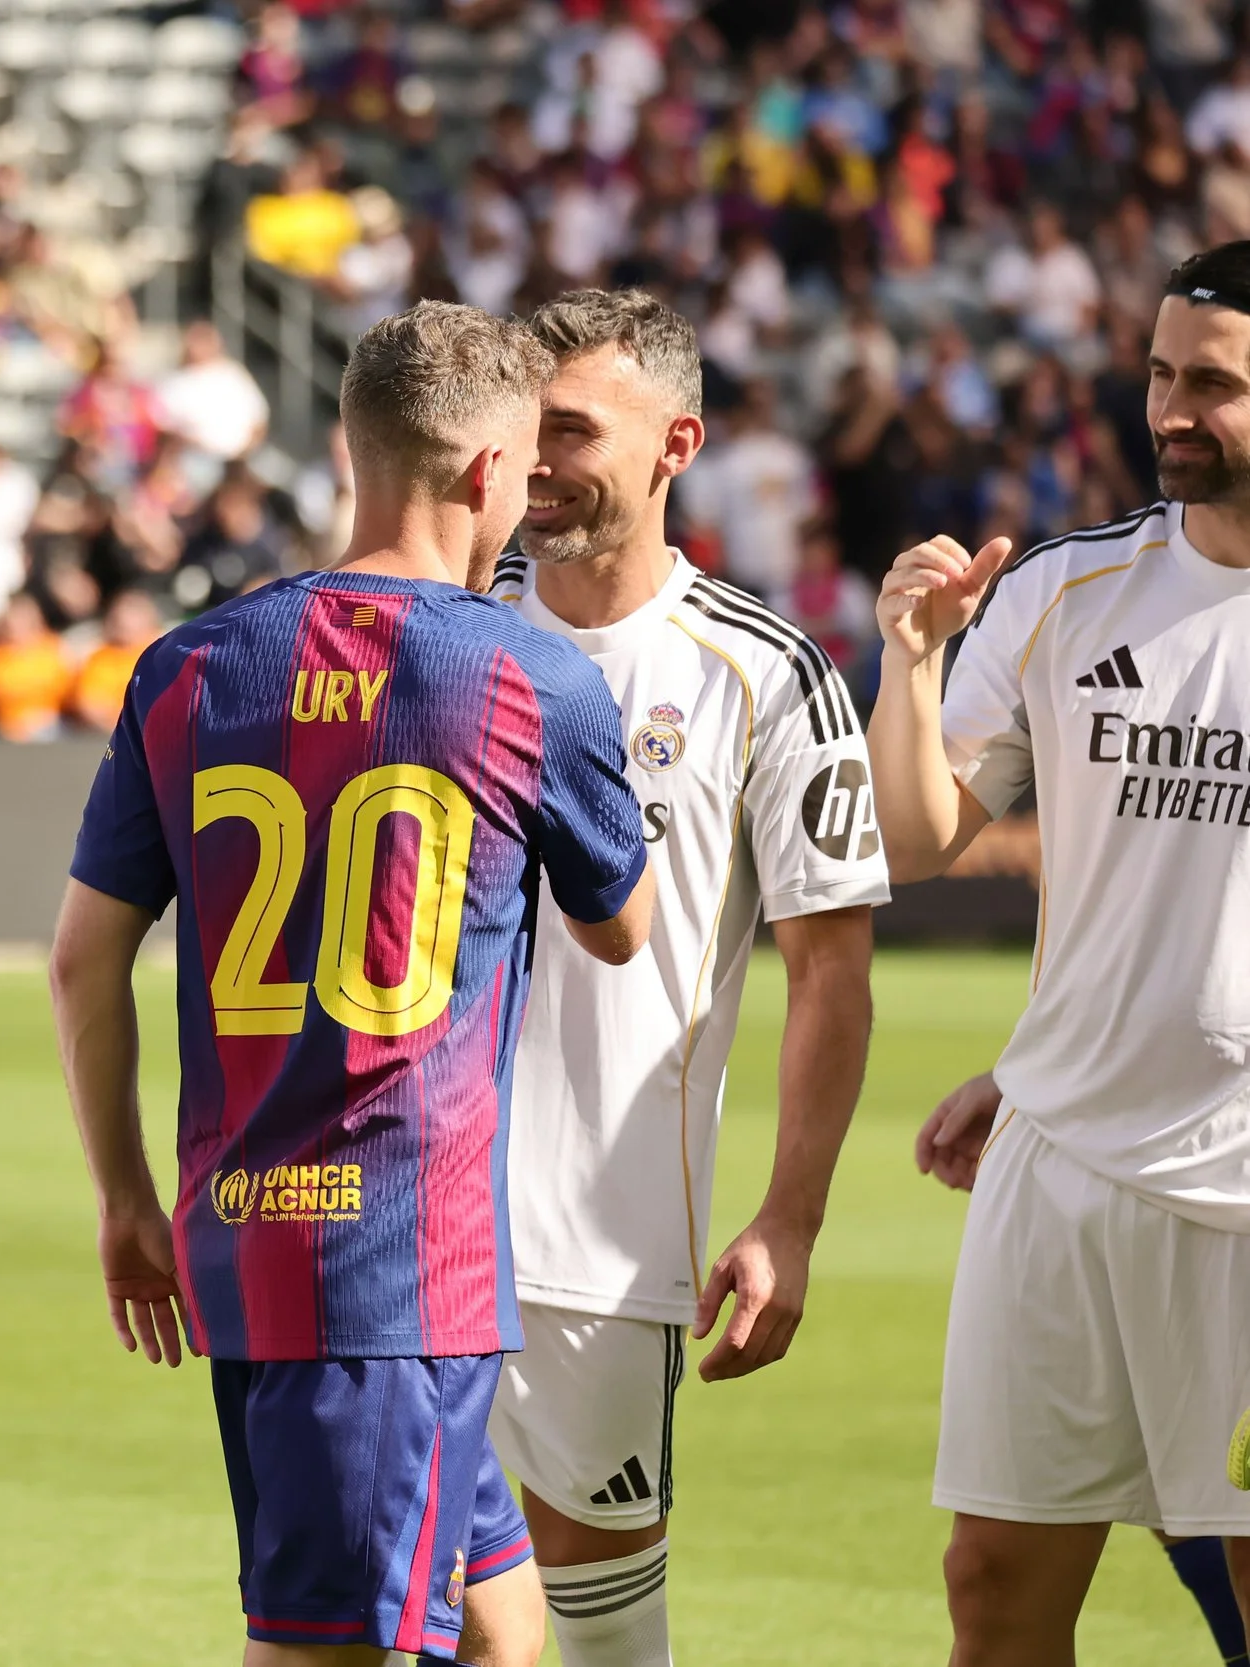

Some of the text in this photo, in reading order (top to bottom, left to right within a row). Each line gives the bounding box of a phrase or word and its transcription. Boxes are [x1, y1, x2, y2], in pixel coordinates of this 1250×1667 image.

[1191, 287, 1216, 300] NIKE
[292, 669, 389, 723] URY
[1089, 712, 1250, 774] Emira
[813, 759, 879, 861] hp
[193, 763, 476, 1037] 20
[263, 1164, 362, 1188] UNHCR
[260, 1188, 361, 1212] ACNUR
[260, 1211, 361, 1223] The UN Refugee Agency
